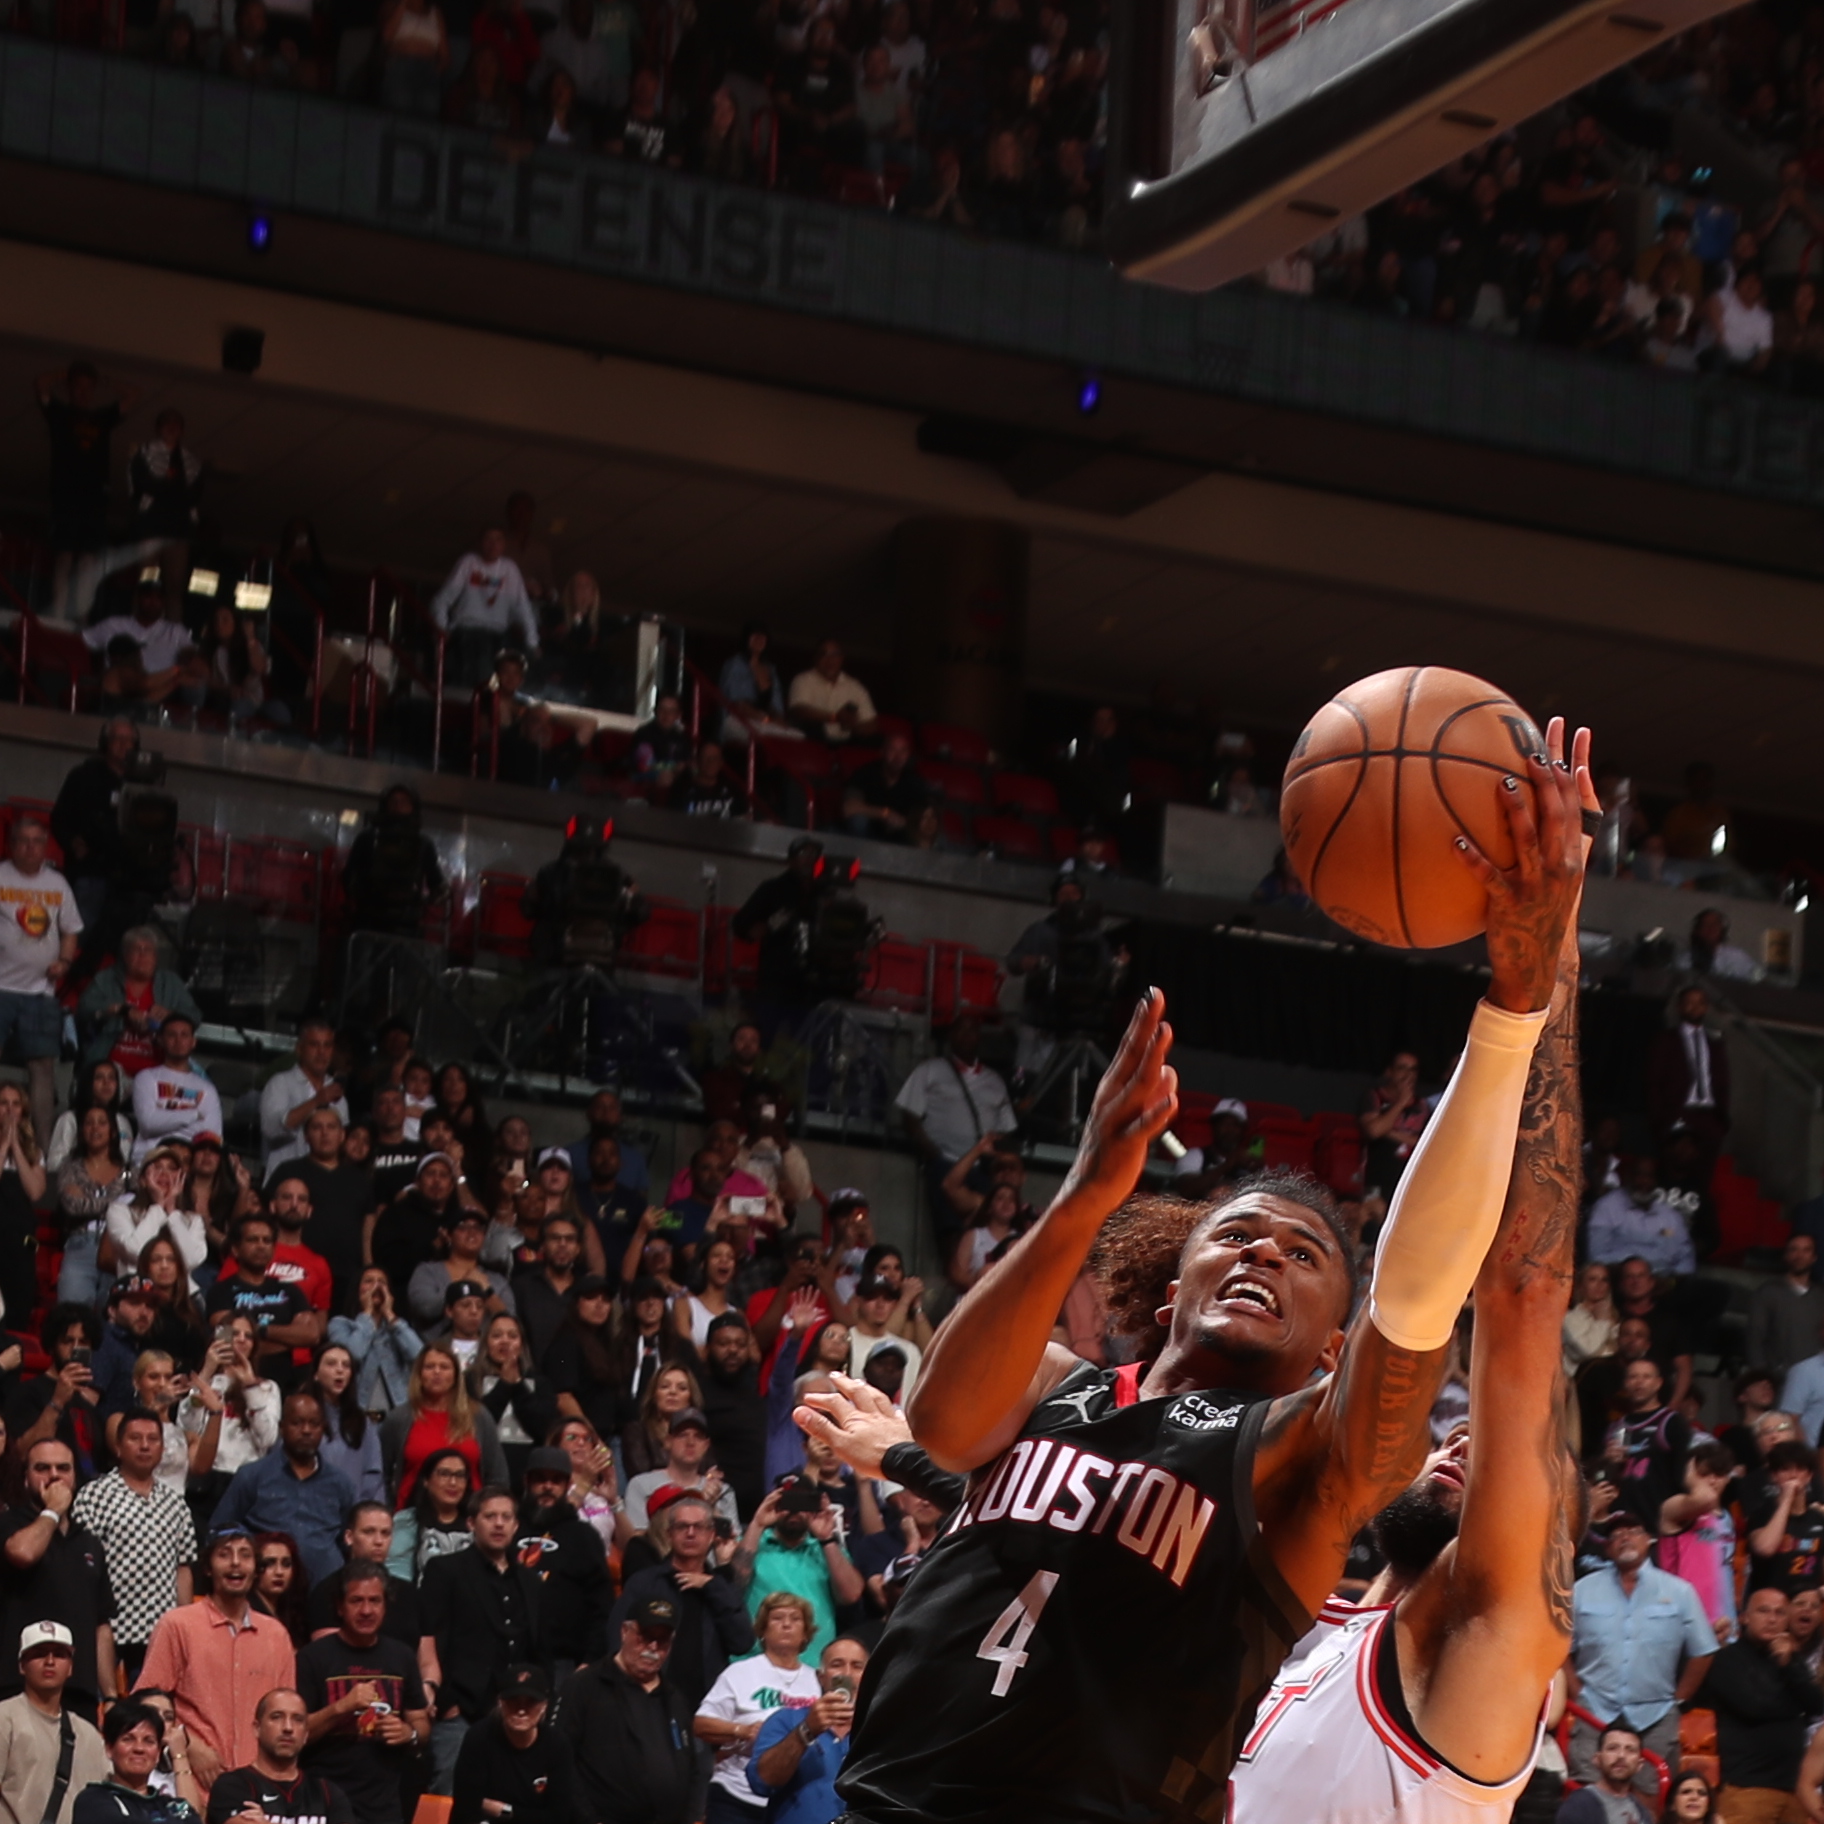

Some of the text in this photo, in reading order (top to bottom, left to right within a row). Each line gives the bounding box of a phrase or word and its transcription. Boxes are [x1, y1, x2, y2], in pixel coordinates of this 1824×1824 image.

[378, 128, 841, 303] DEFENSE
[374, 1153, 418, 1169] MIAM
[1167, 1403, 1238, 1431] karma
[1183, 1395, 1245, 1419] credit
[948, 1438, 1220, 1590] HOUSTON
[975, 1568, 1061, 1700] 4
